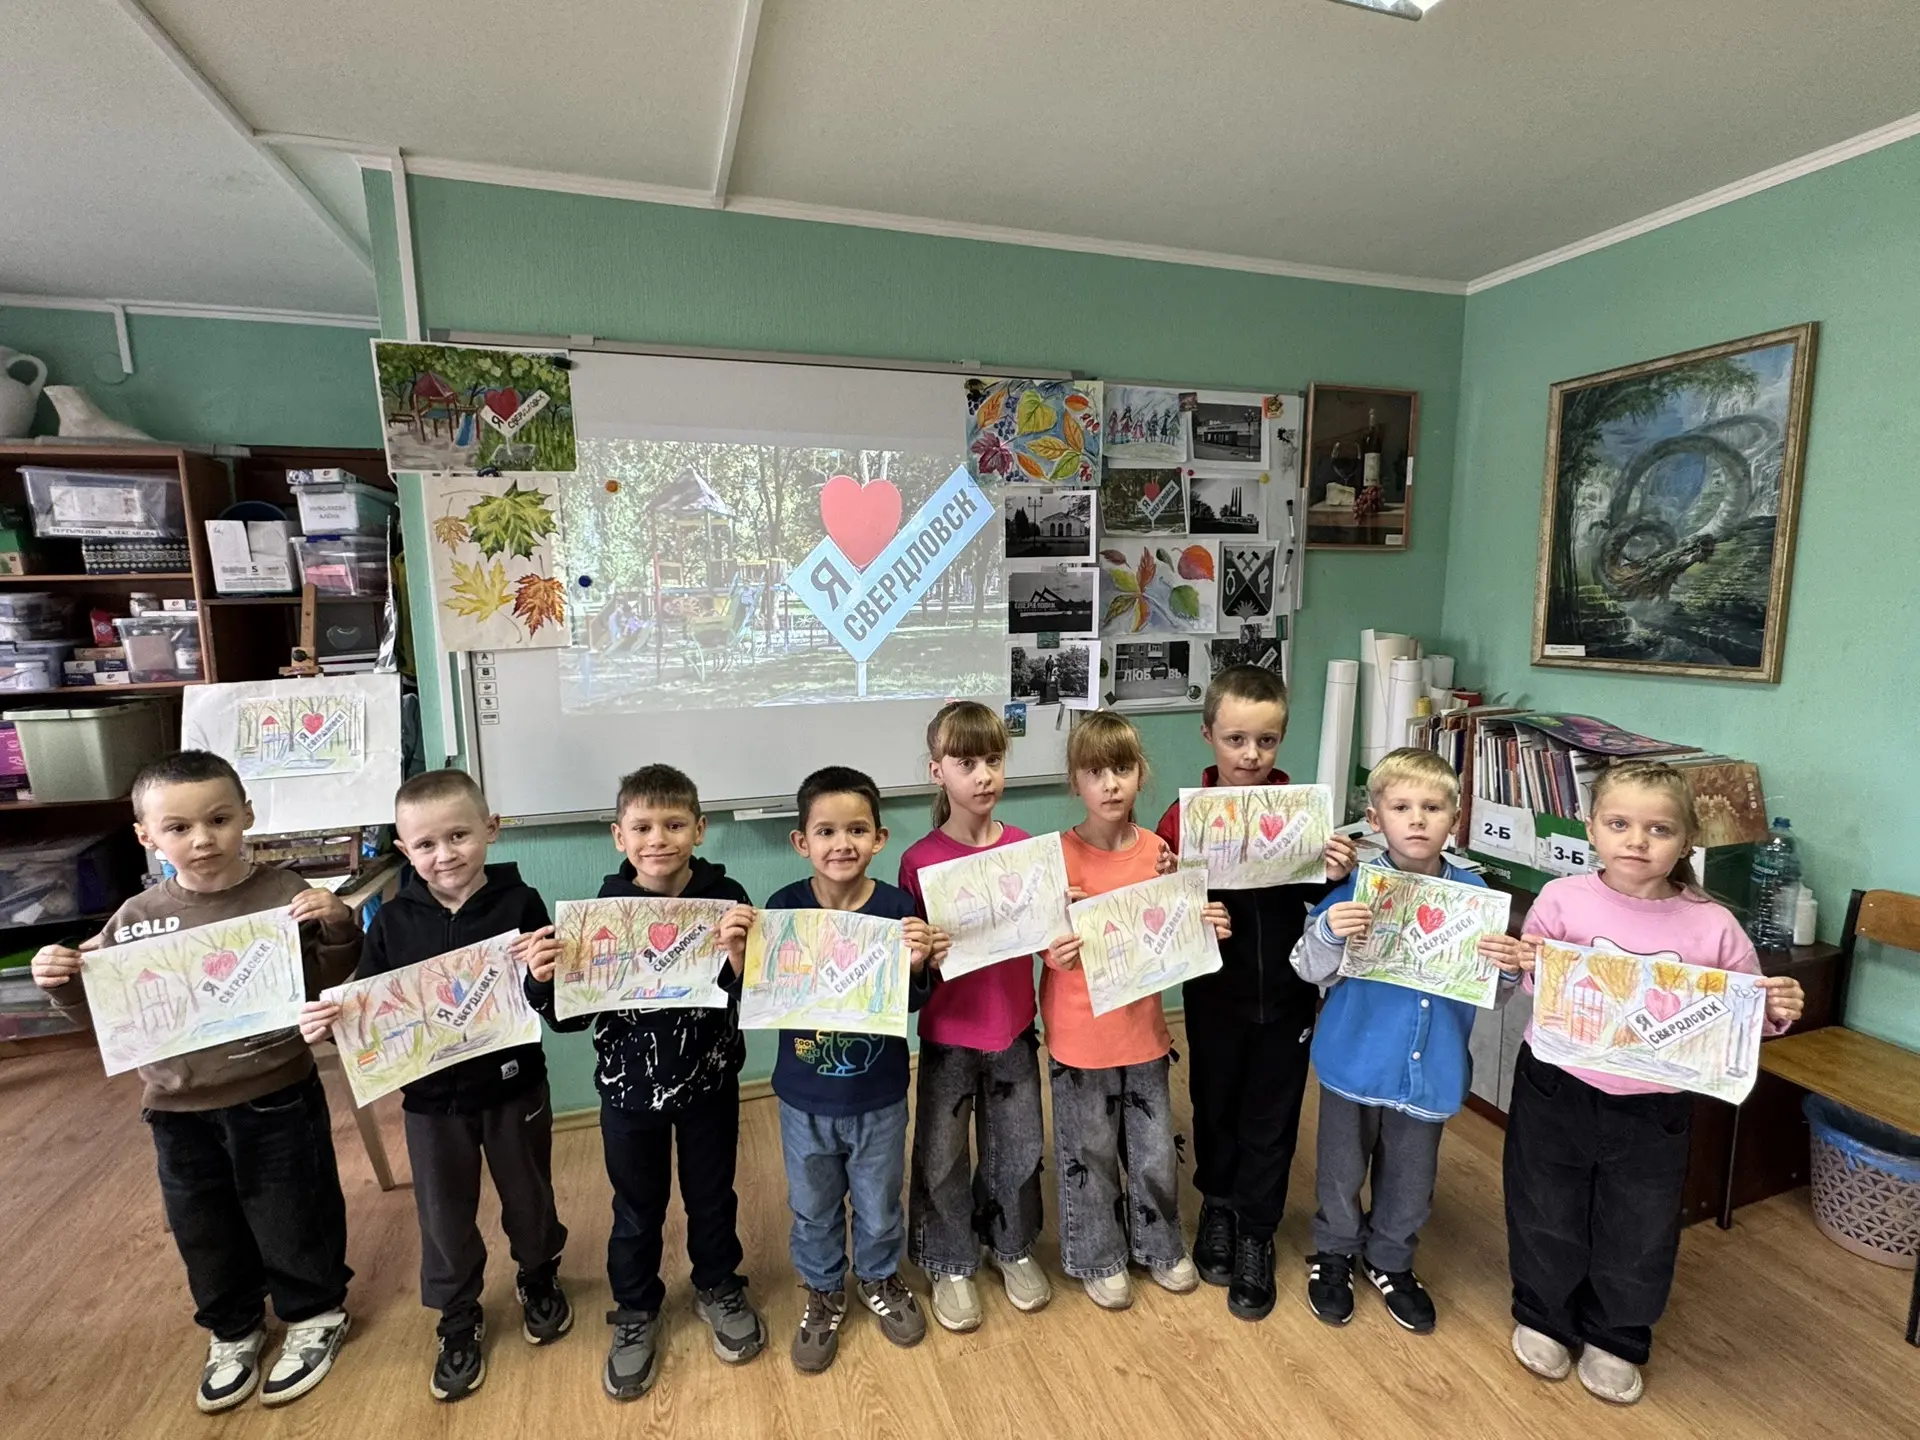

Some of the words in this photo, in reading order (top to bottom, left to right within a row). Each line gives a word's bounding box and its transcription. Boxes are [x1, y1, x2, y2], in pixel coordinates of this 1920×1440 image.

[492, 415, 504, 429] Я
[1142, 500, 1151, 509] Я
[843, 488, 978, 642] СВЕРДЛОВСК
[810, 557, 852, 611] Я
[299, 732, 309, 743] Я
[1483, 822, 1511, 840] 2-Б
[1554, 846, 1584, 866] 3-Б
[1143, 933, 1154, 948] Я
[1410, 927, 1421, 943] Я
[644, 949, 657, 963] Я
[653, 924, 707, 972] СВЕРДЛОВСК
[825, 966, 838, 982] Я
[203, 981, 220, 997] Я
[437, 1008, 453, 1022] Я
[1635, 1014, 1653, 1032] Я
[1649, 1001, 1721, 1044] СВЕРДЛОВСК
